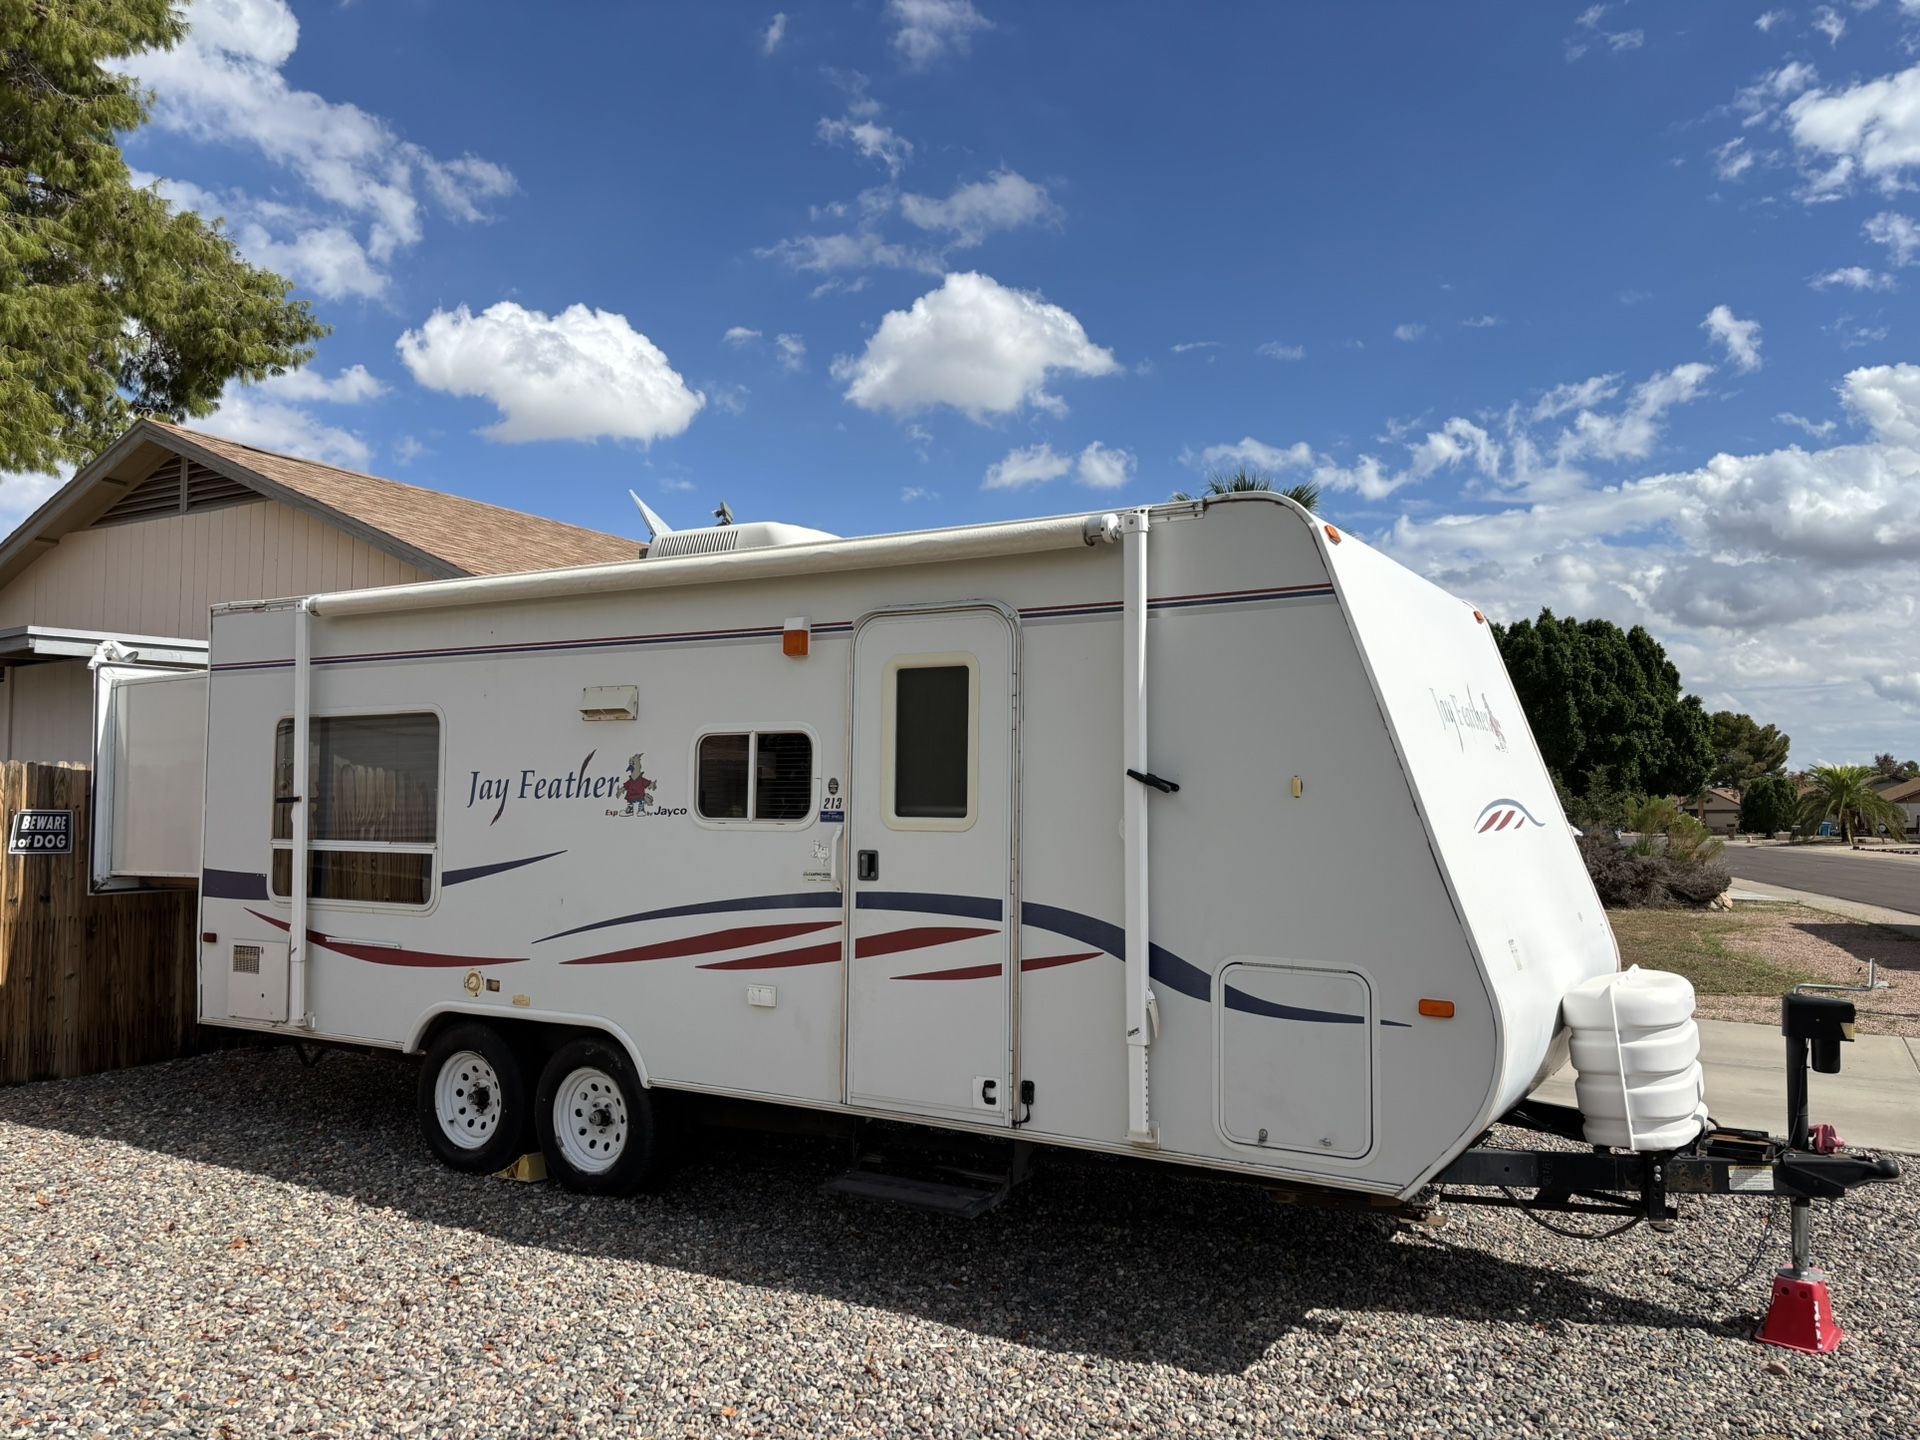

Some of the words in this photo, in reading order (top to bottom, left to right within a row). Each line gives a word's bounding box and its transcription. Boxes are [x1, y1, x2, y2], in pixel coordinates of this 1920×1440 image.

[466, 770, 510, 827] Jay
[517, 748, 620, 800] Feather
[823, 797, 843, 810] 213
[654, 806, 688, 818] Jayco
[21, 815, 67, 830] BEWARE
[17, 835, 32, 848] of
[33, 834, 67, 848] DOG
